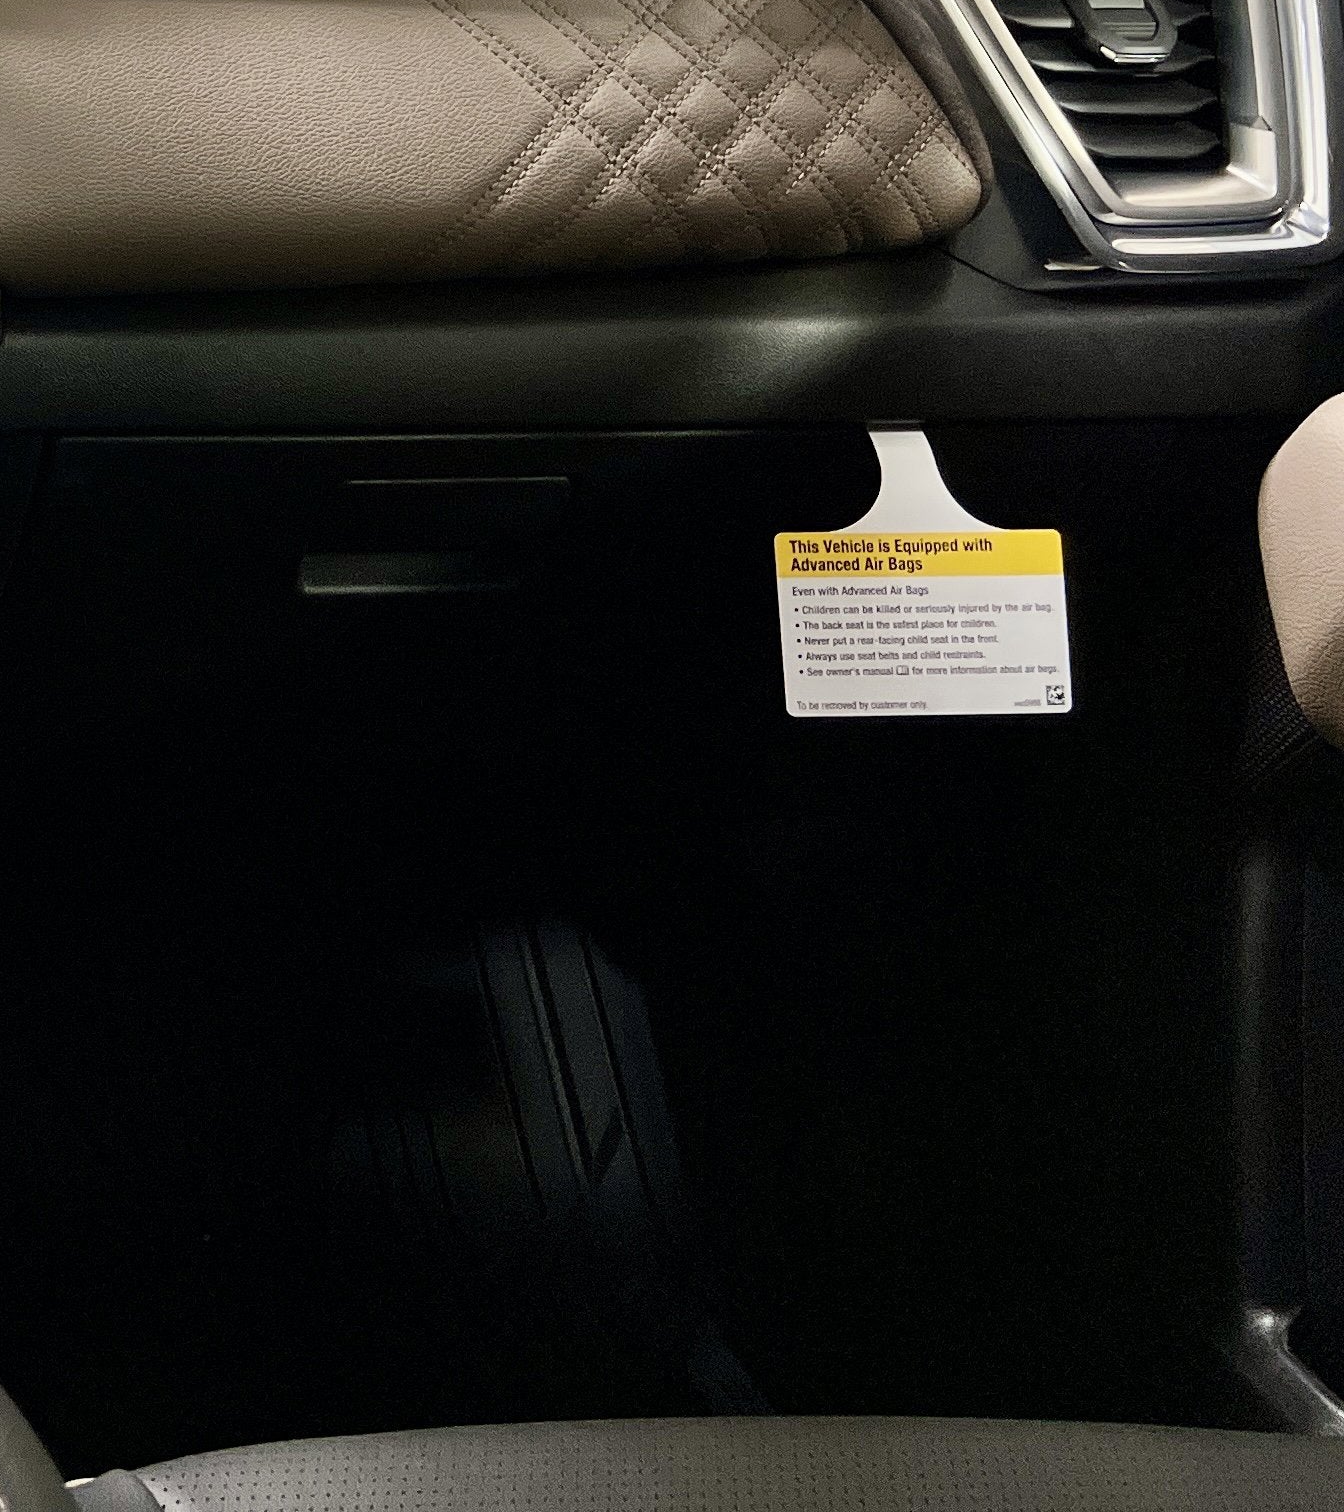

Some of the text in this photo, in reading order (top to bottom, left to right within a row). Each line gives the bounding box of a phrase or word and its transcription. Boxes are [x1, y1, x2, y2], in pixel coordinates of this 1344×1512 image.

[789, 538, 993, 555] This Vehicle is Equipped with
[791, 557, 923, 573] Advanced Air Bags
[792, 585, 929, 597] Even with Advanced Air Bags
[802, 605, 840, 614] Children
[843, 606, 859, 614] can
[862, 605, 873, 614] be
[876, 605, 900, 613] killed
[915, 604, 955, 614] seriously
[958, 603, 990, 614] injured
[992, 603, 1002, 613] by
[1005, 603, 1018, 612] the
[802, 621, 819, 629] The
[822, 621, 843, 629] back
[845, 621, 864, 629] seat
[866, 621, 873, 629] is
[876, 620, 890, 629] the
[946, 619, 957, 628] for
[804, 636, 830, 645] Never
[833, 636, 847, 647] put
[907, 635, 928, 644] child
[930, 635, 949, 644] seat
[951, 635, 959, 643] in
[961, 635, 975, 643] the
[806, 652, 837, 662] Always
[840, 653, 855, 661] use
[857, 652, 876, 660] seat
[902, 651, 918, 660] and
[920, 650, 941, 659] child
[807, 667, 823, 676] See
[863, 667, 893, 676] manual
[912, 666, 923, 675] for
[926, 667, 948, 675] more
[797, 701, 807, 710] To
[809, 701, 820, 710] be
[859, 701, 869, 710] by
